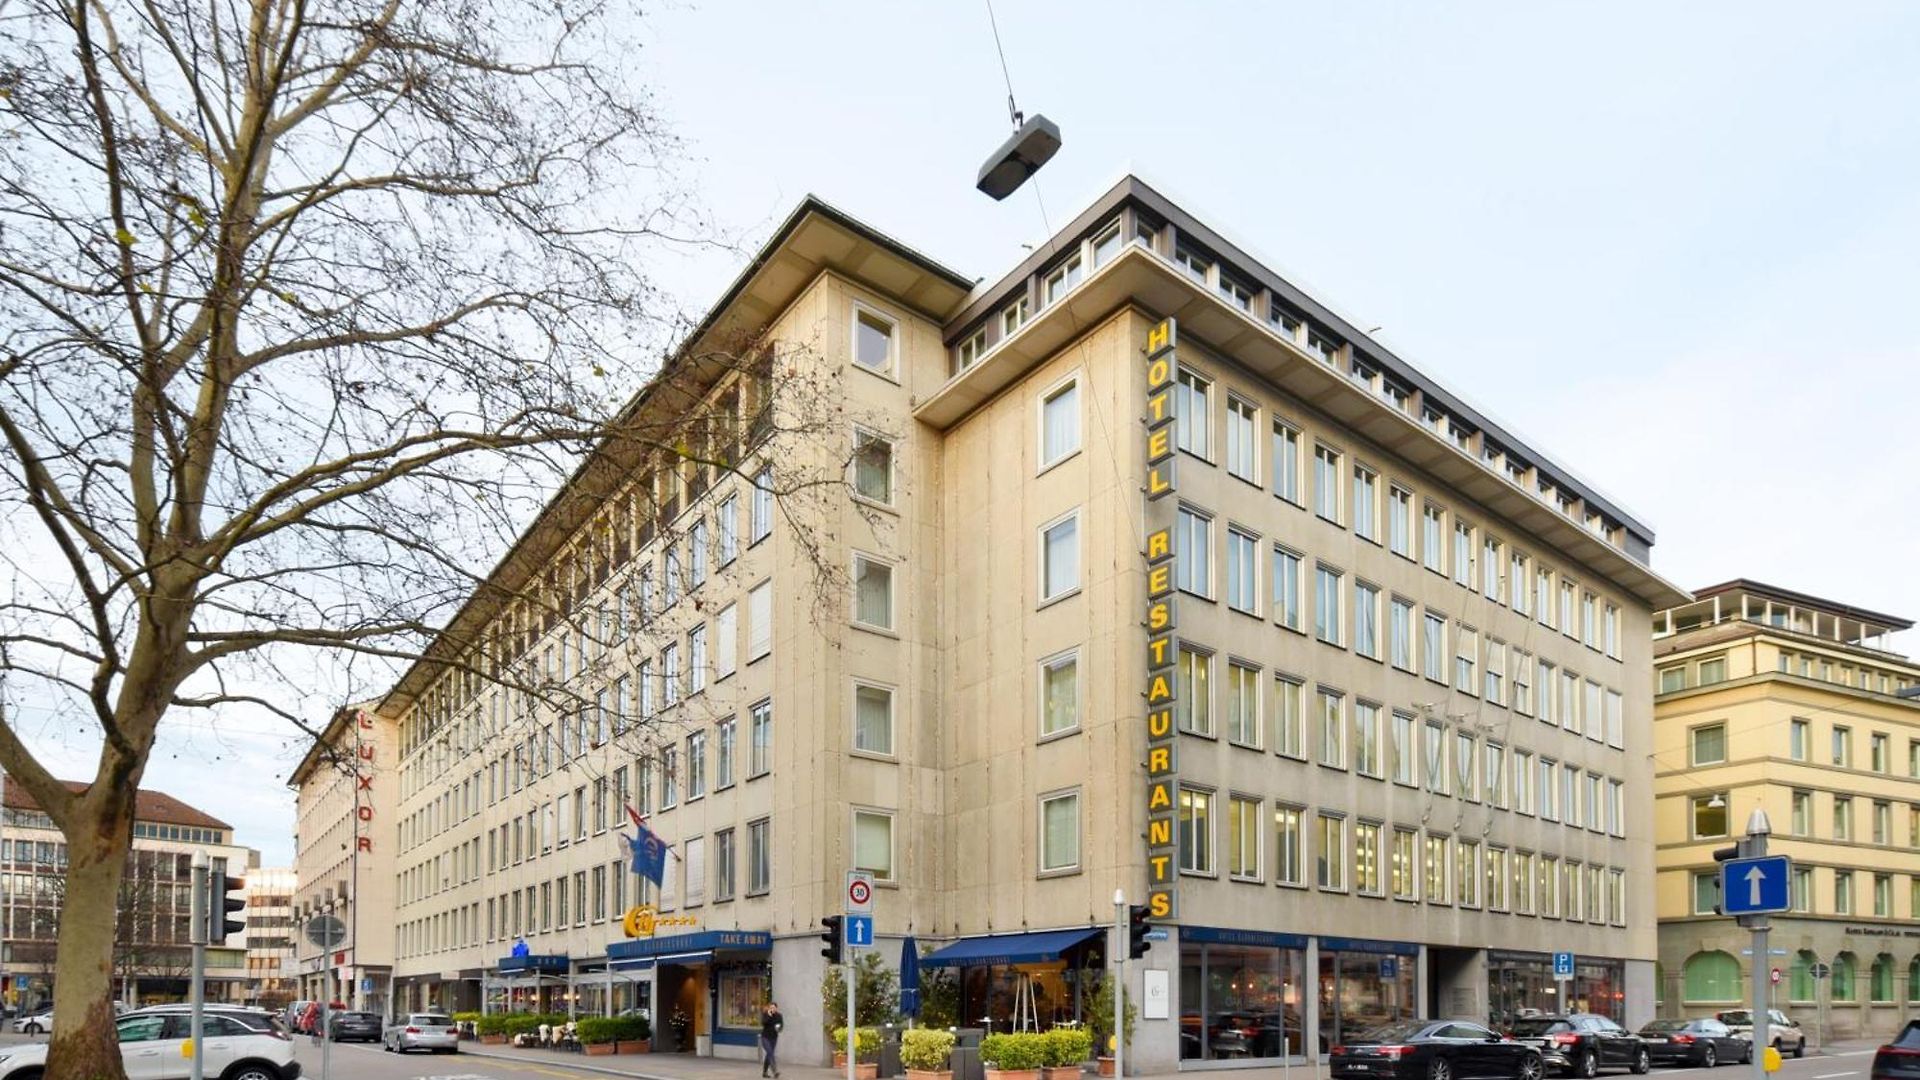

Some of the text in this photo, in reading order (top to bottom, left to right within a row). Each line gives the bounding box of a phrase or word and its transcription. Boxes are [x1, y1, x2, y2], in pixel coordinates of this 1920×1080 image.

[1148, 322, 1169, 494] HOTEL
[1149, 531, 1170, 917] RESTAURANTS
[358, 711, 373, 853] LUXOR
[855, 887, 865, 897] 30
[720, 934, 767, 945] TAKE AWAY
[1560, 954, 1568, 965] P
